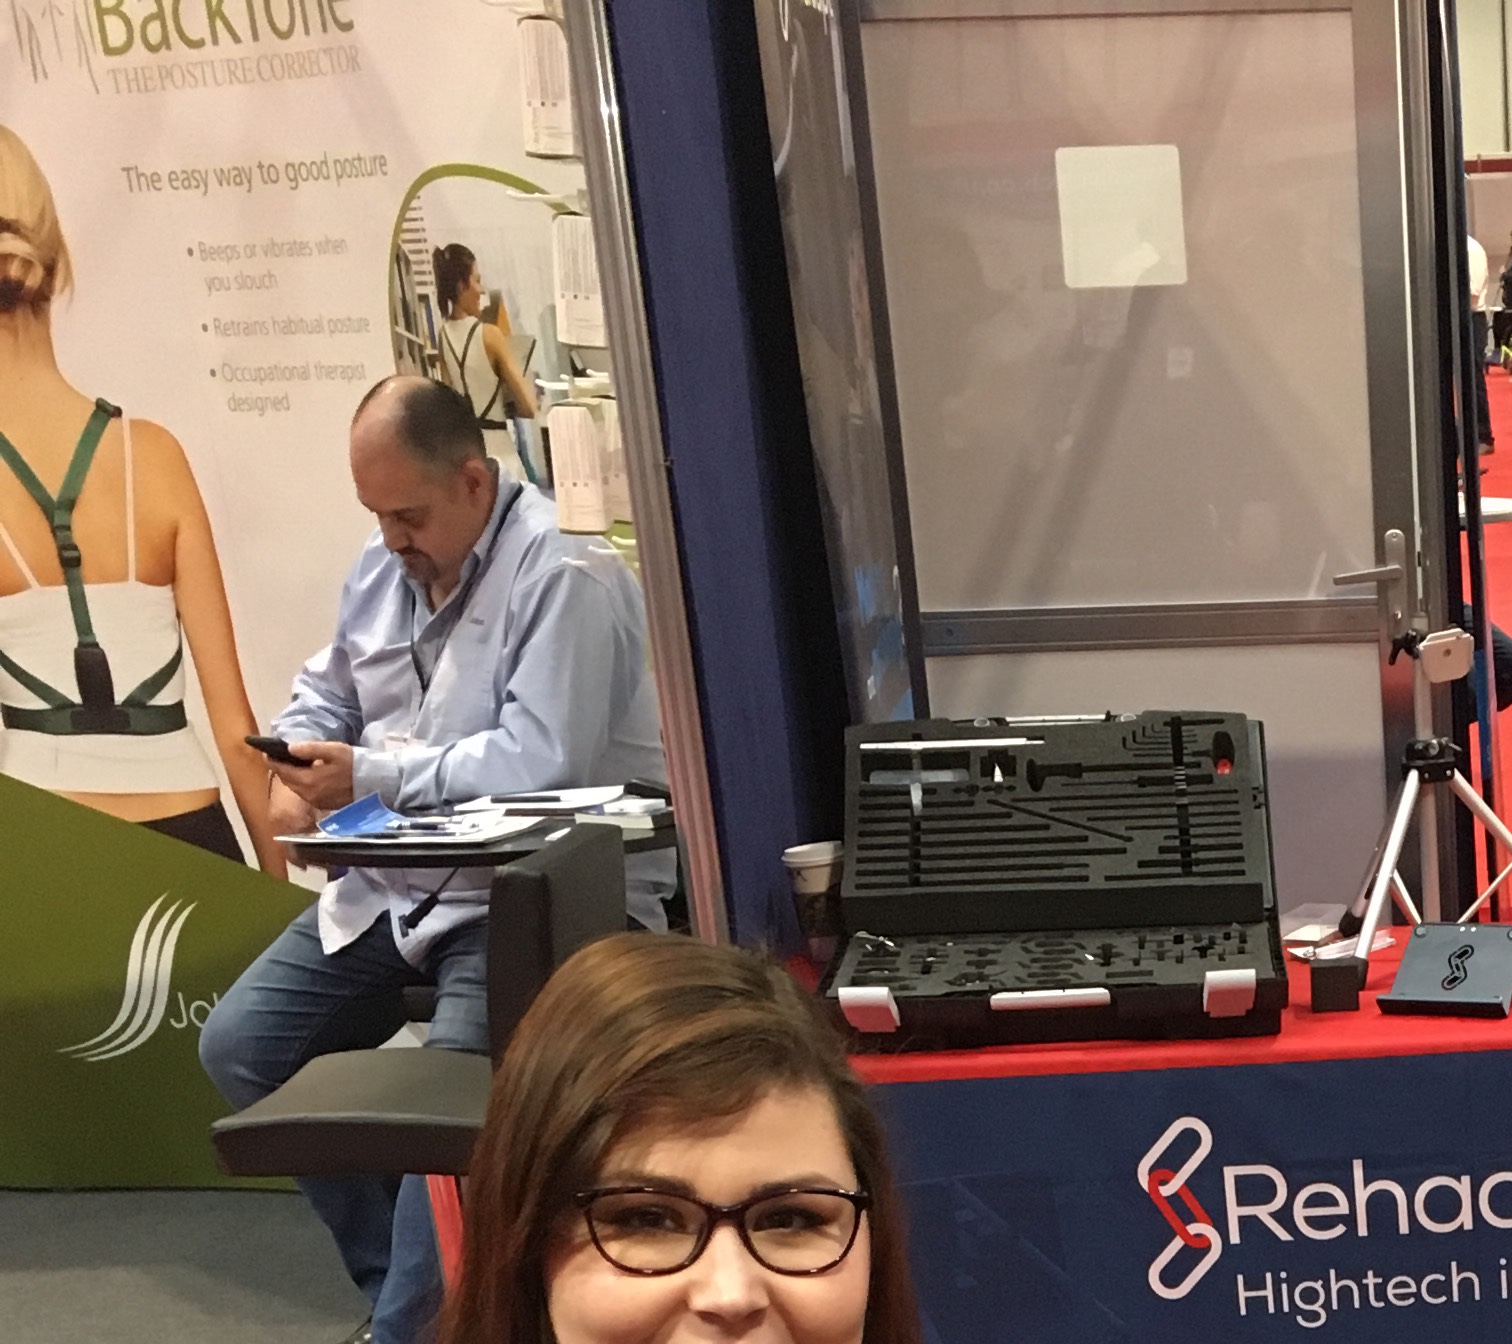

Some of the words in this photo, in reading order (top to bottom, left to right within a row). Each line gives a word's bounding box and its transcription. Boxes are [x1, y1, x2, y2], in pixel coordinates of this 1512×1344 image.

[107, 66, 157, 94] THE
[158, 57, 253, 89] POSTURE
[256, 45, 362, 81] CORRECTOR
[121, 165, 162, 193] The
[168, 167, 210, 196] easy
[213, 164, 253, 193] way
[257, 160, 280, 184] to
[285, 151, 330, 190] good
[333, 153, 388, 183] posture
[198, 241, 240, 264] Beeps
[243, 244, 258, 259] or
[260, 236, 313, 257] vibrates
[315, 235, 348, 256] when
[204, 274, 232, 296] you
[234, 270, 278, 290] slouch
[213, 317, 270, 337] Retrains
[273, 314, 325, 335] habitual
[328, 316, 371, 337] posture
[221, 362, 311, 386] Occupational
[314, 361, 367, 385] therapist
[227, 391, 291, 417] designed
[1237, 1261, 1481, 1328] Hightech
